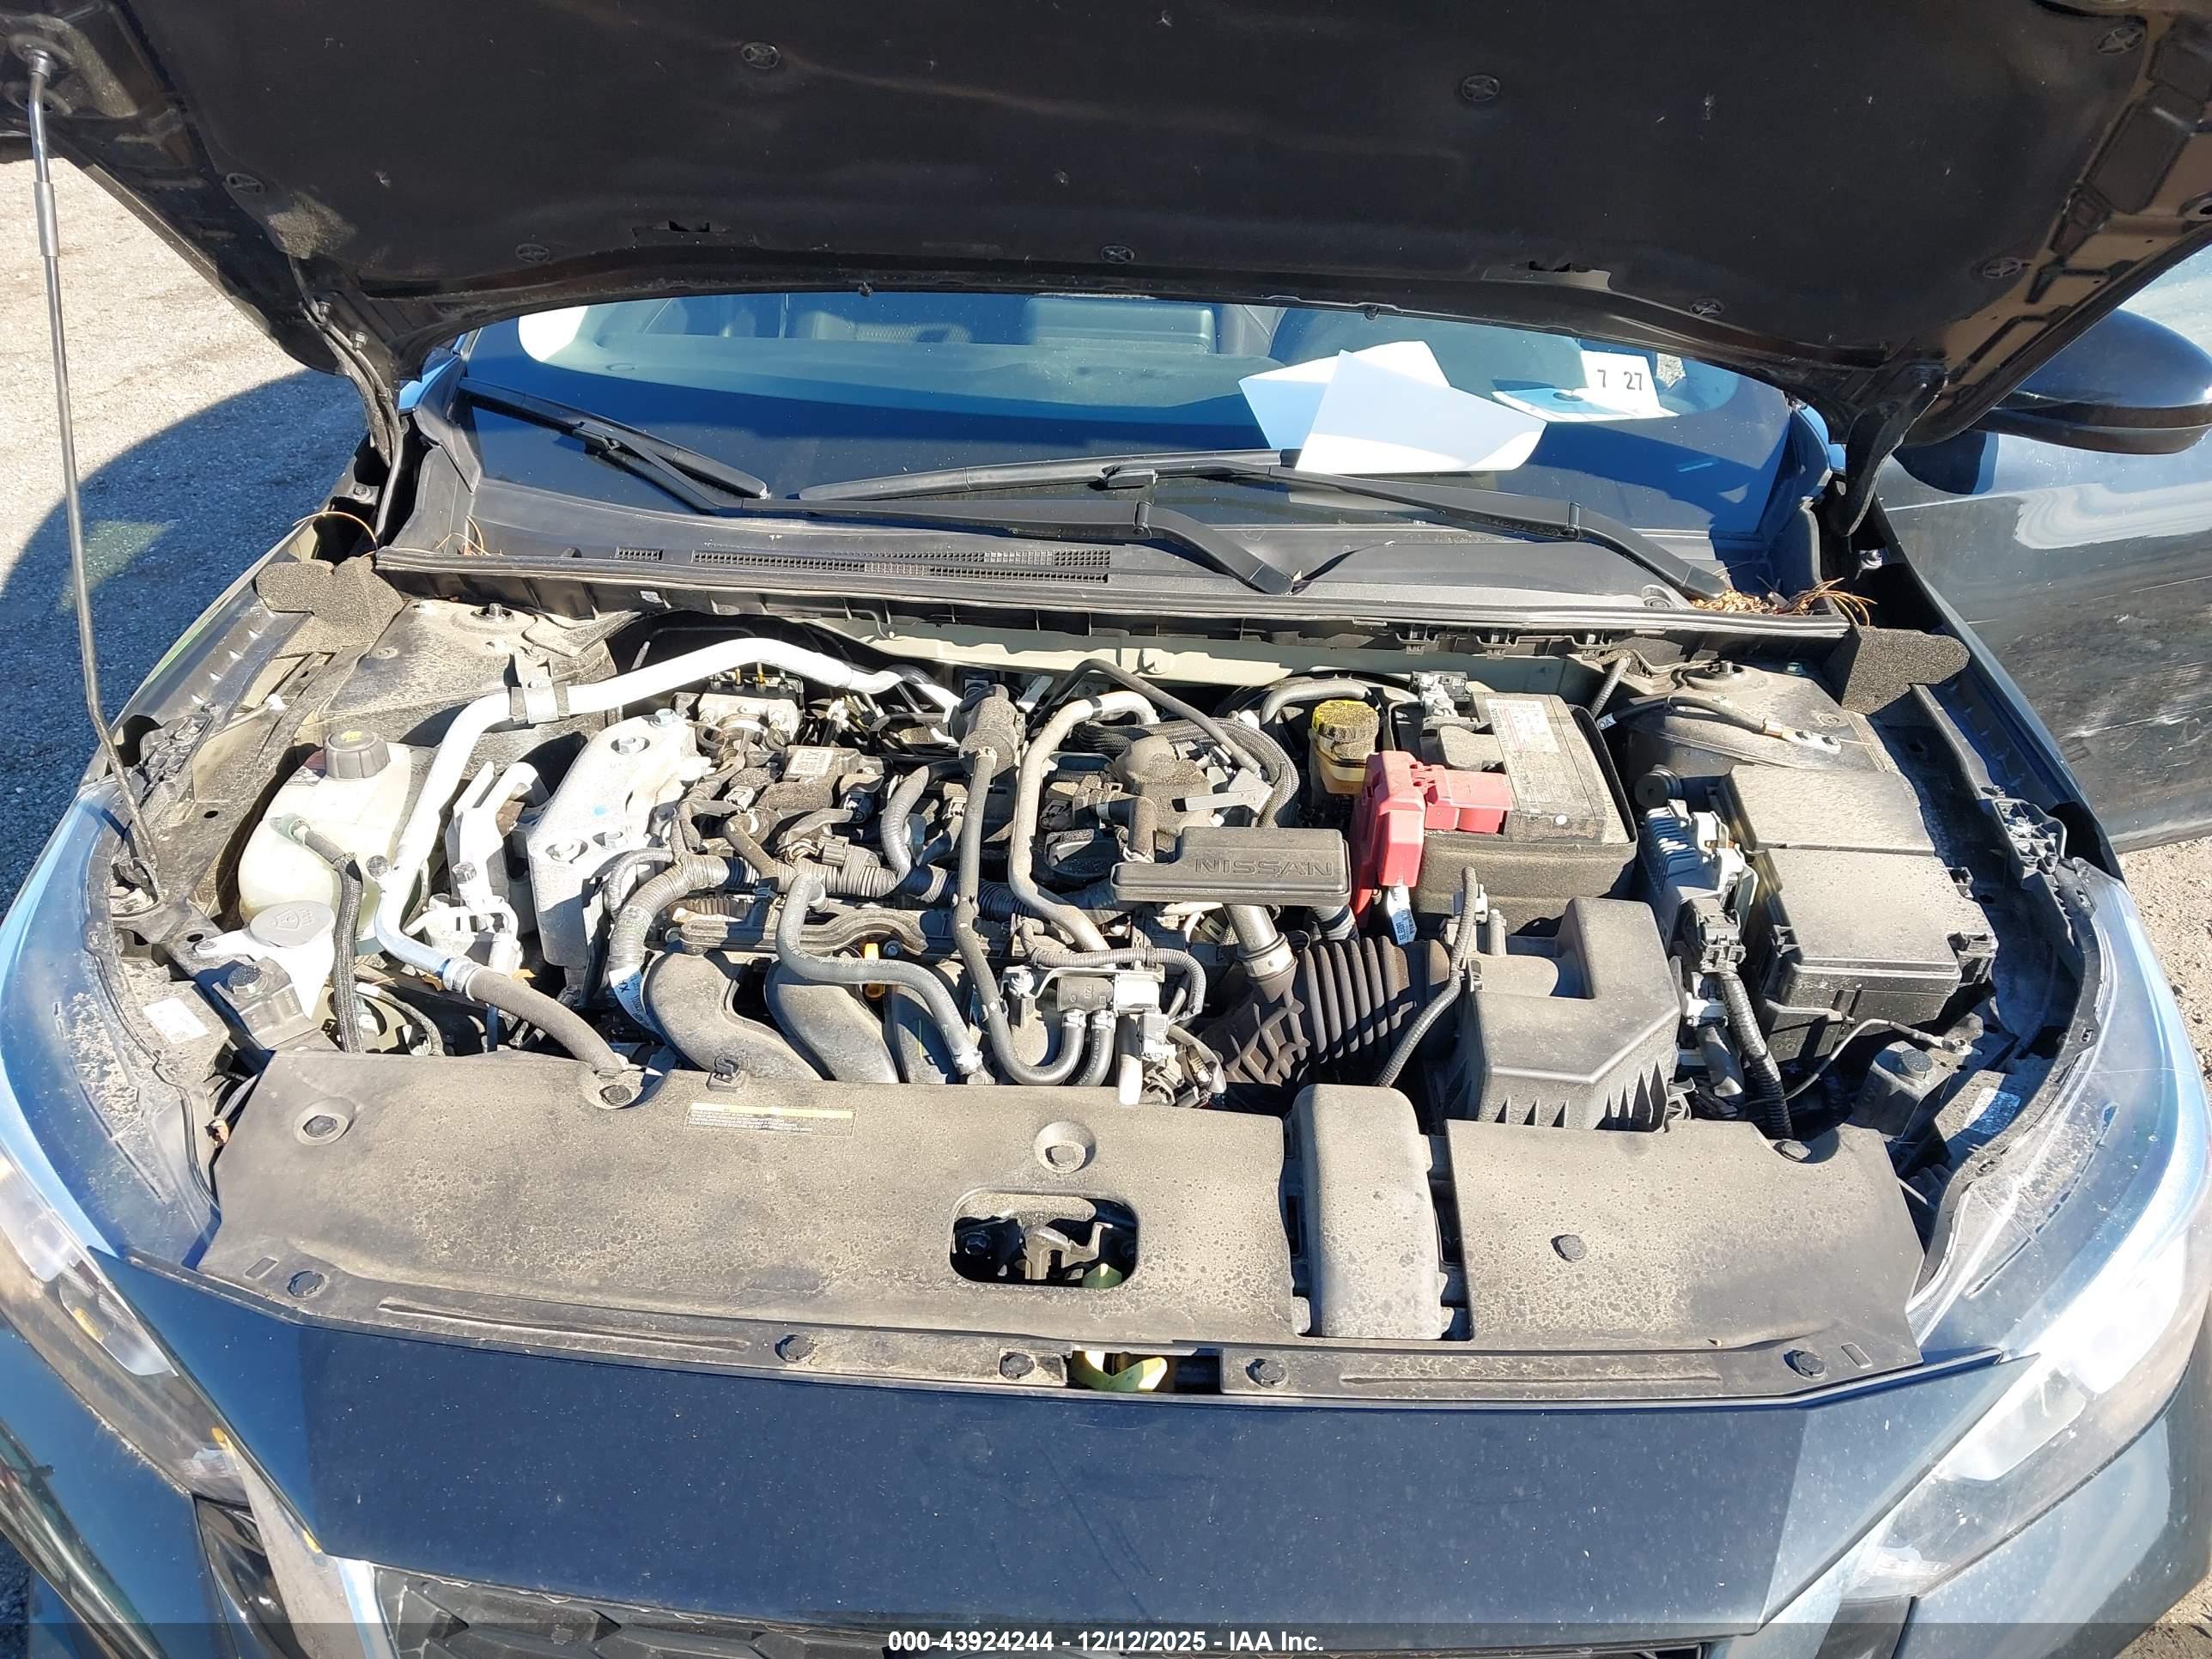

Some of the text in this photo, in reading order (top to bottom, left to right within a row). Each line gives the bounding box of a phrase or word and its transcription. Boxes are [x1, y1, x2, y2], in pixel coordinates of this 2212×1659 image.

[1597, 369, 1642, 391] 7 27
[1490, 708, 1503, 729] NISSAN
[1194, 858, 1334, 877] NISSAN
